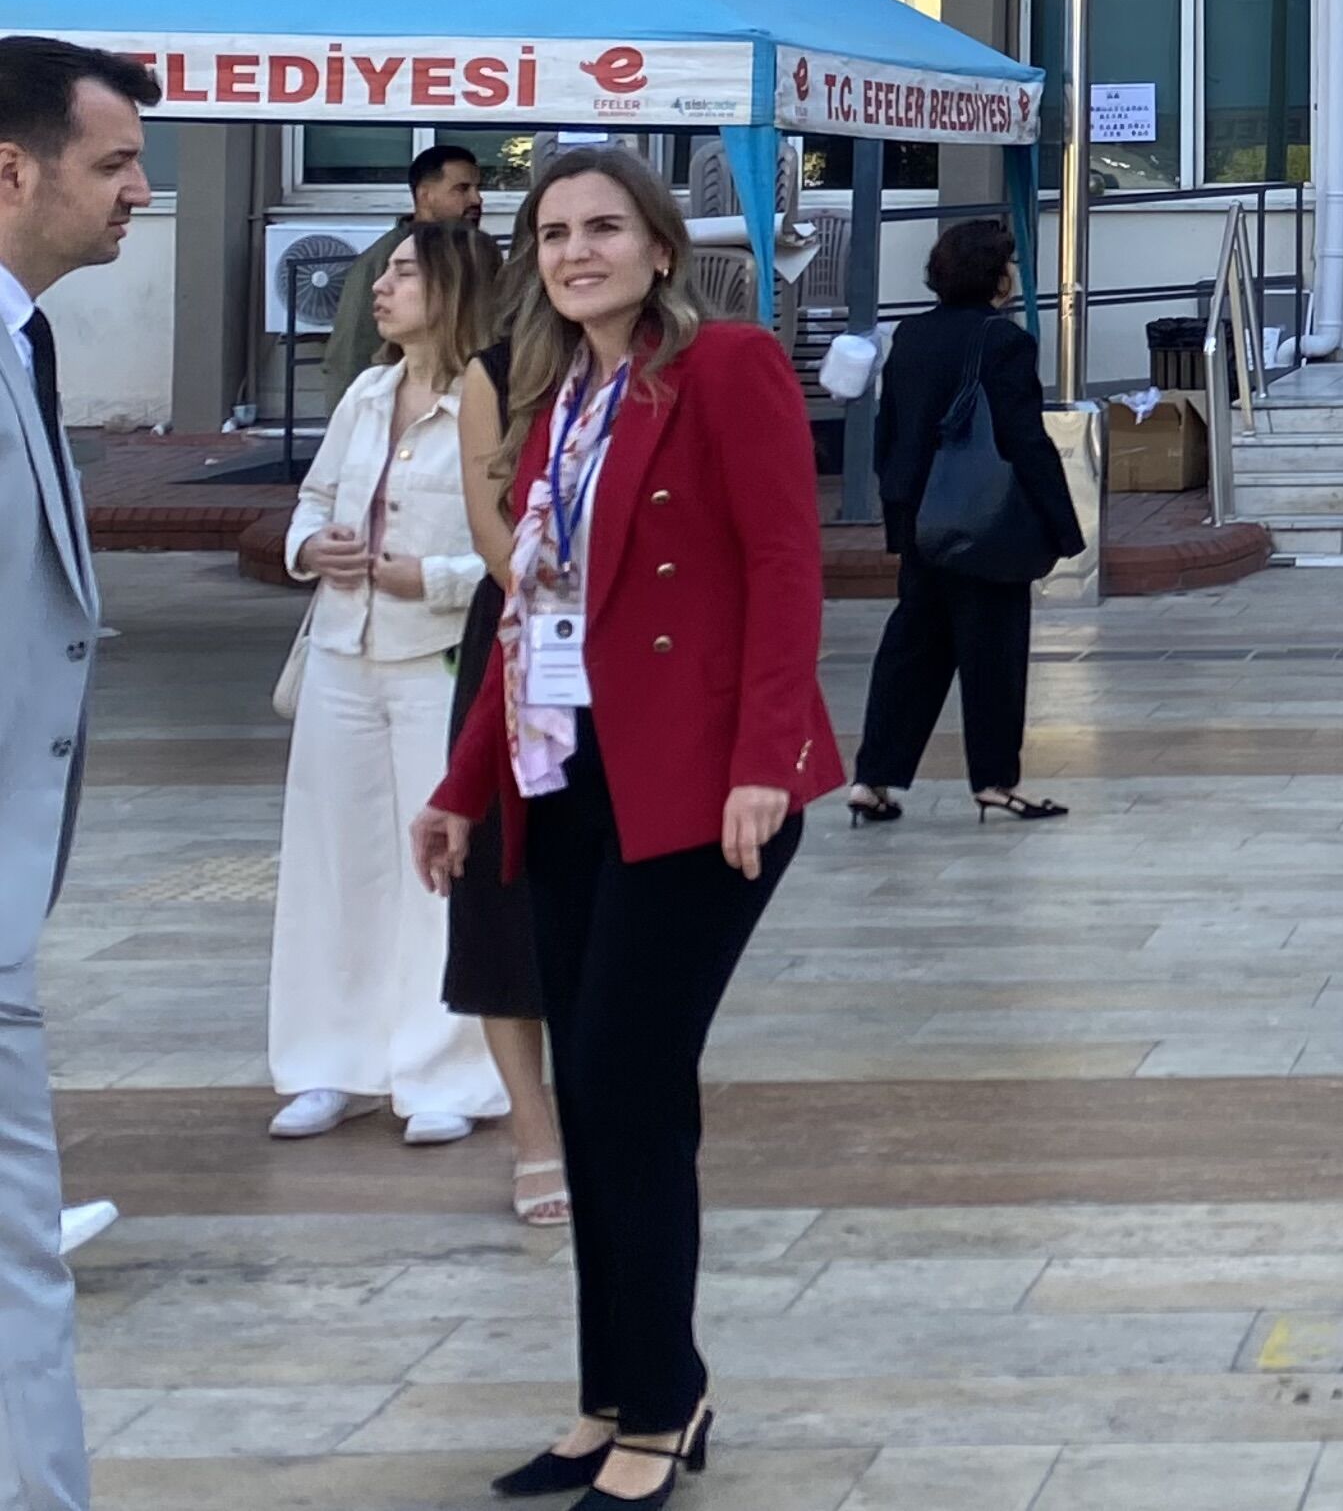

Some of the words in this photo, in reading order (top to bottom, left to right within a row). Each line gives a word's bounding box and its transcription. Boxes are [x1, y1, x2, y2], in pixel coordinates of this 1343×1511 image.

[116, 42, 537, 107] LEDİYESİ
[593, 99, 641, 110] EFELER
[824, 73, 857, 122] T.C.
[863, 79, 925, 129] EFELER
[929, 83, 1012, 134] BELEDİYESİ
